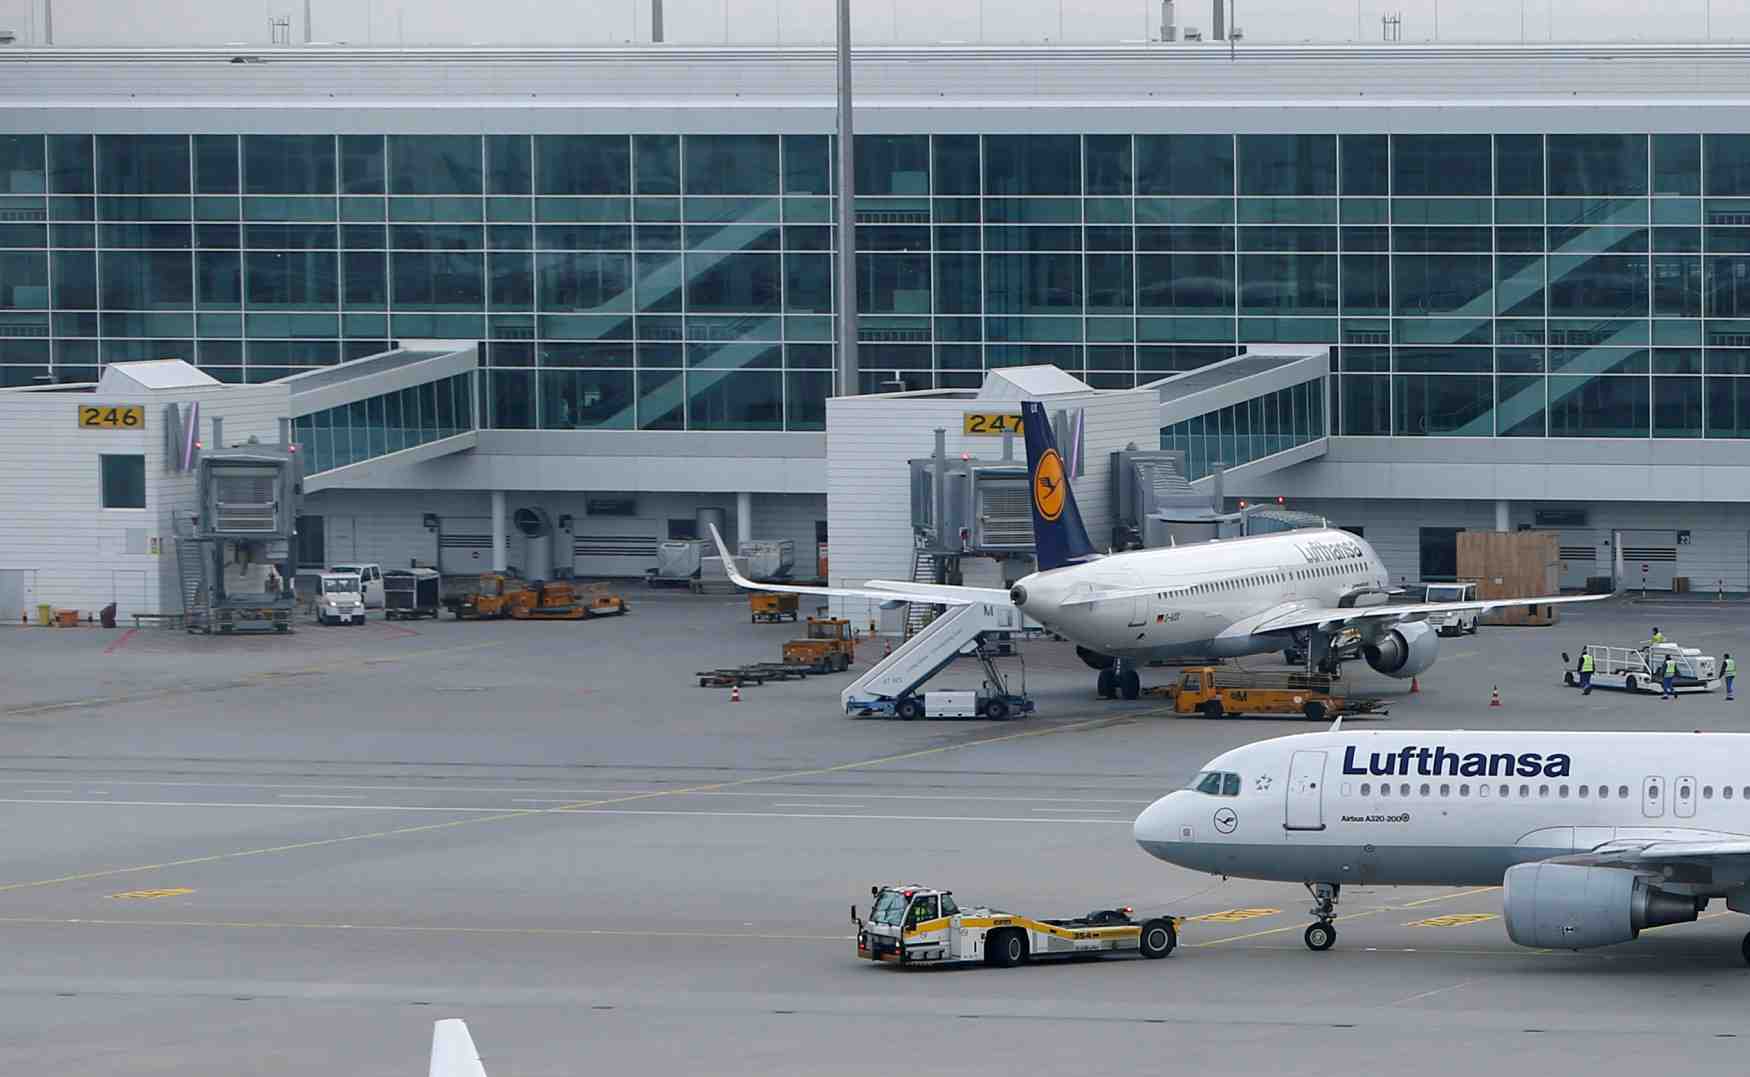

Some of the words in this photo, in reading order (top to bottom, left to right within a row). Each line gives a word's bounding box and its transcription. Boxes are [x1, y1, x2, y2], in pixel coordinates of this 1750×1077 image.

[84, 408, 137, 426] 246
[970, 414, 1024, 432] 247
[1343, 745, 1572, 777] Lufthansa
